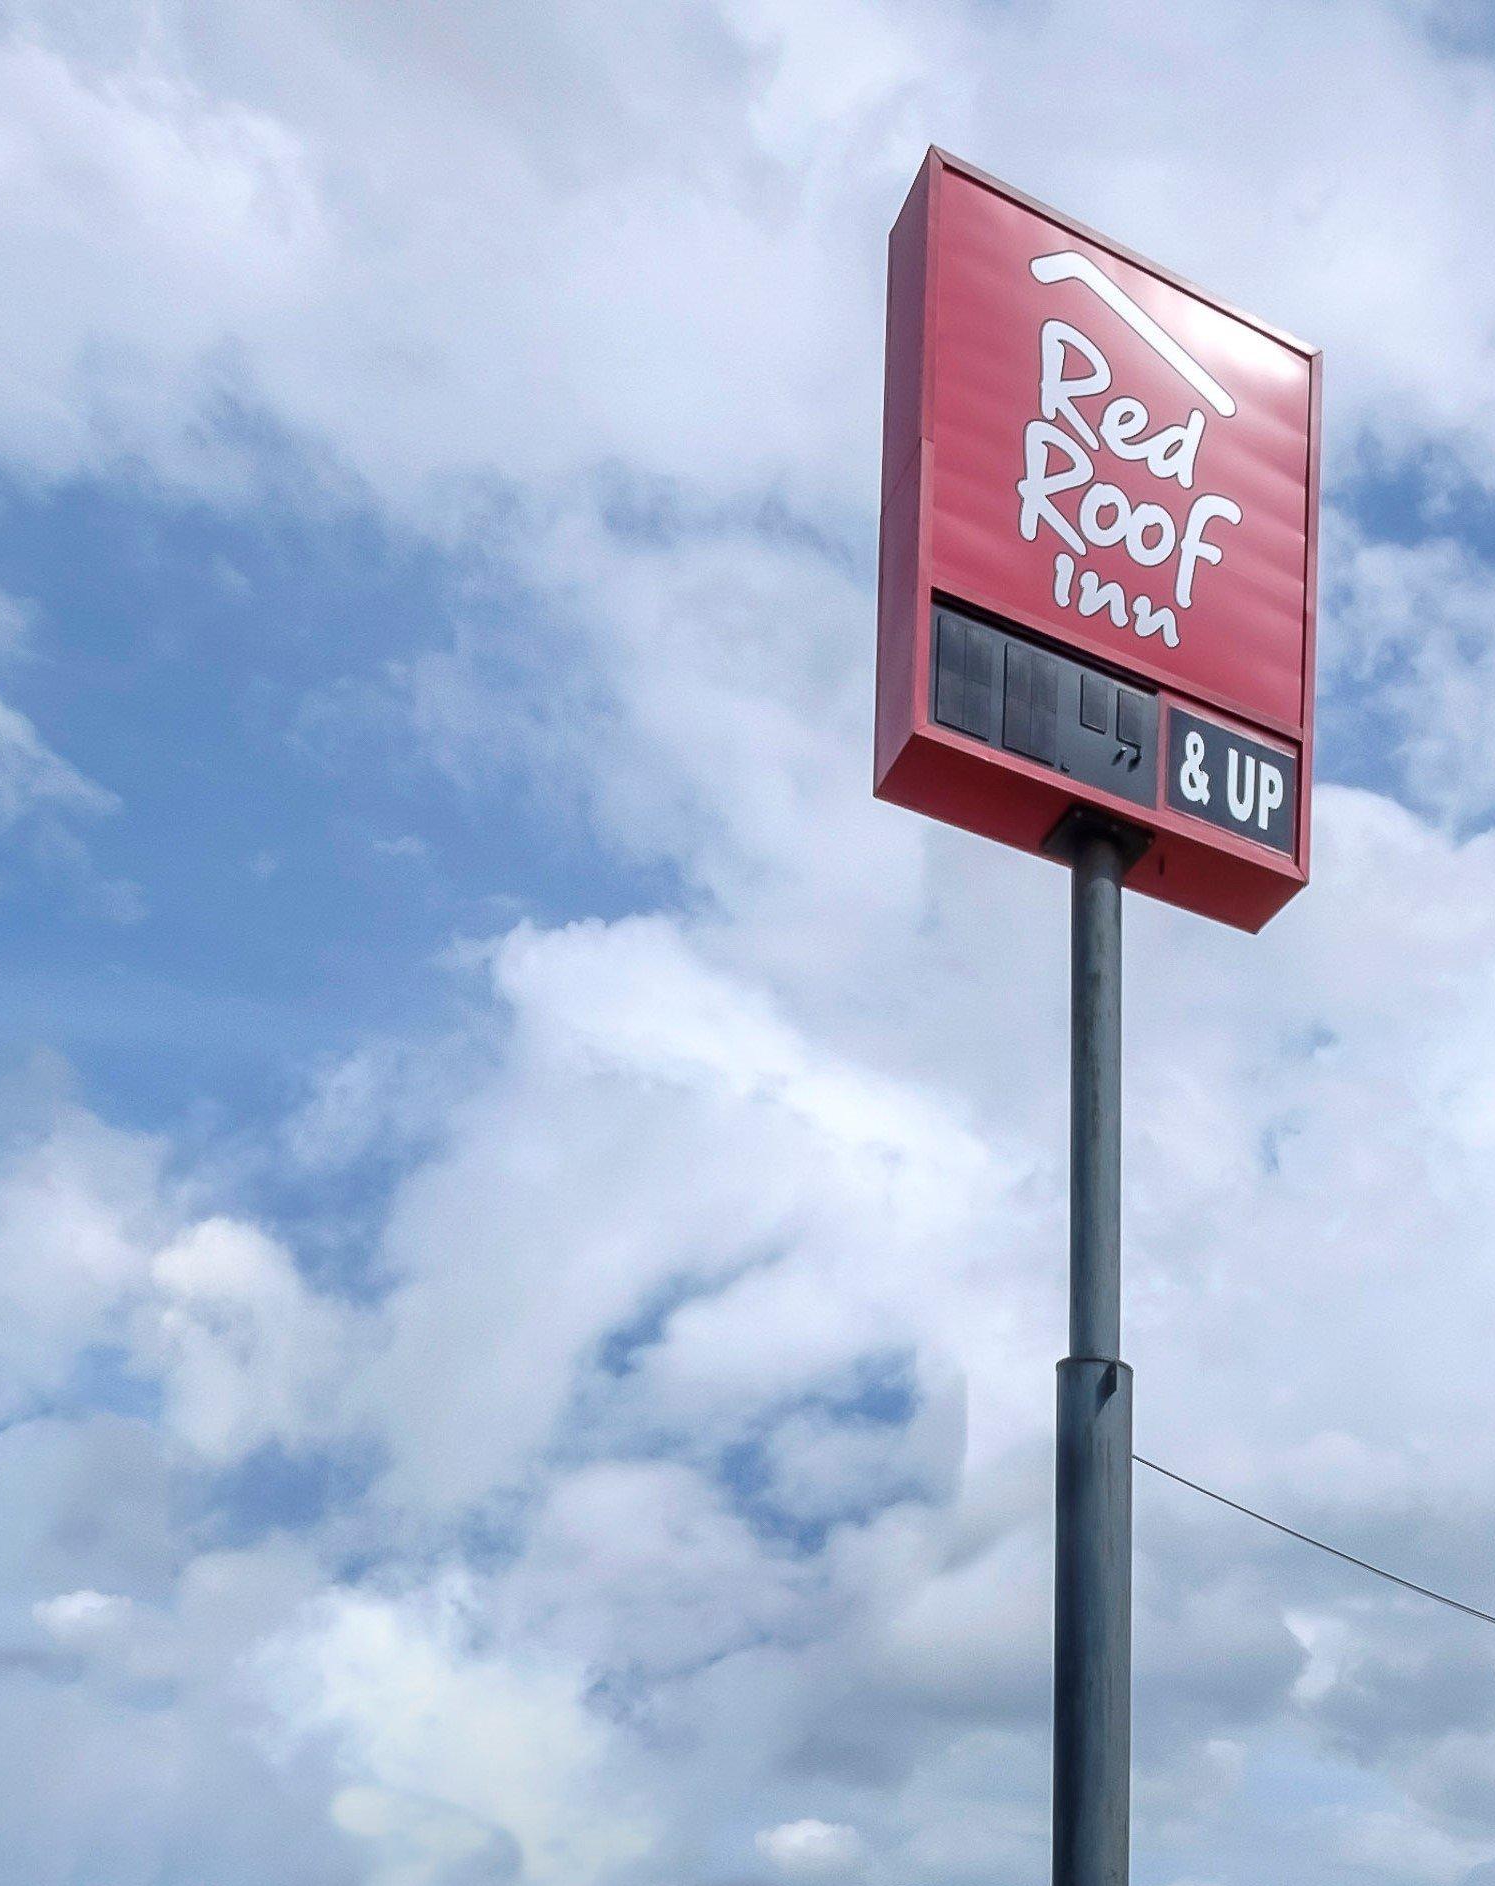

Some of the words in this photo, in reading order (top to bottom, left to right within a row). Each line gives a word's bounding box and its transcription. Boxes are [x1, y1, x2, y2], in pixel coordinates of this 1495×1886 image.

[1039, 319, 1205, 489] Red
[1017, 419, 1243, 610] Roof
[1054, 553, 1180, 649] Inn
[1179, 729, 1212, 807] &
[1225, 746, 1285, 831] UP
